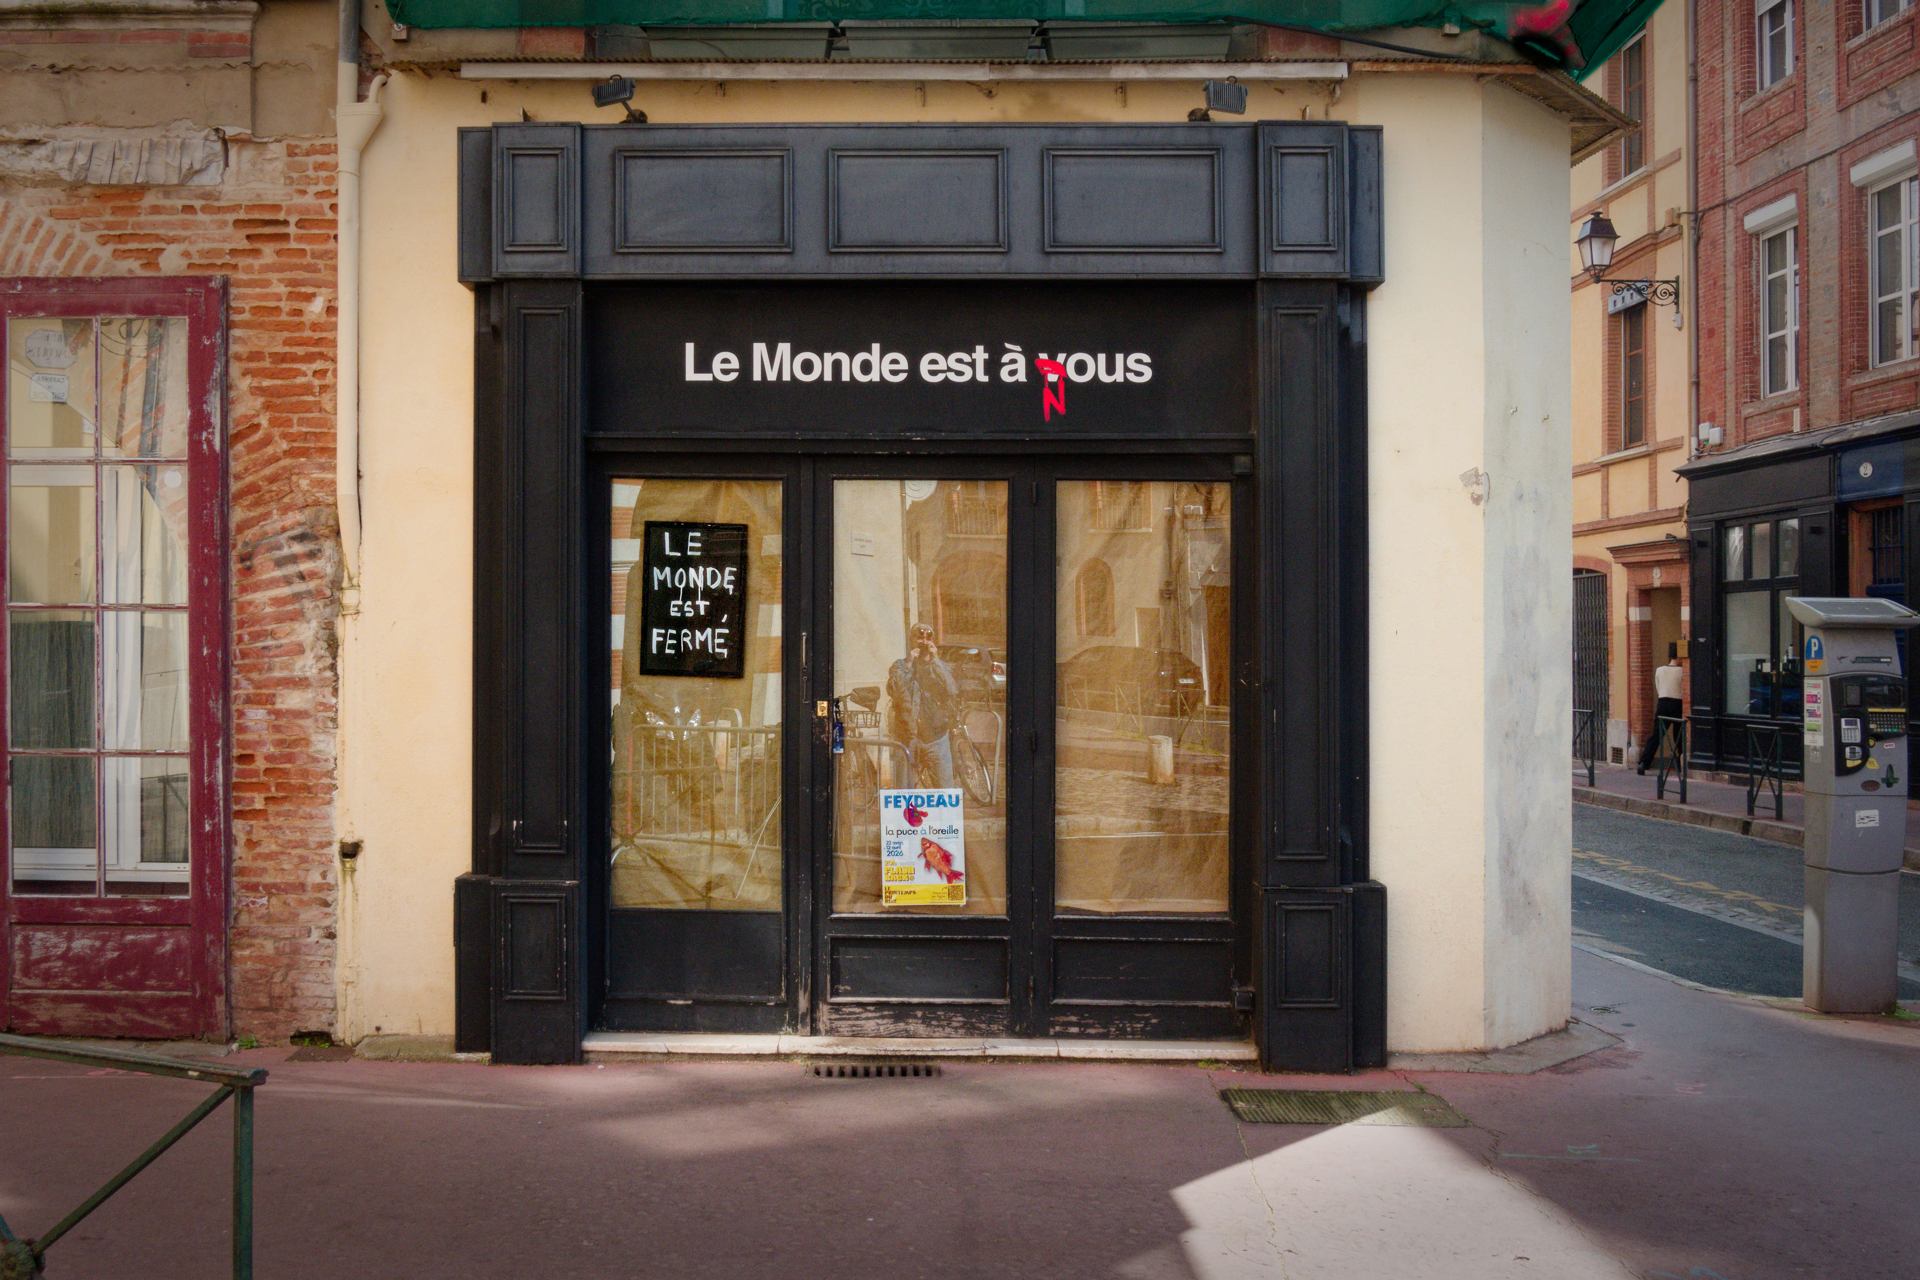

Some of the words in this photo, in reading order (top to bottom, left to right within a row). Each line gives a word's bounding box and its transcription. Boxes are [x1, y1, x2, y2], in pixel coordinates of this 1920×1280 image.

[685, 342, 740, 383] Le
[752, 342, 909, 383] Monde
[919, 345, 990, 383] est
[1000, 342, 1028, 383] à
[664, 531, 702, 556] LE
[653, 565, 738, 595] MONDE
[670, 600, 710, 617] EST
[651, 614, 730, 658] FERMÉ
[884, 793, 960, 809] FEYDEAU
[885, 825, 894, 836] la
[896, 828, 918, 838] puce
